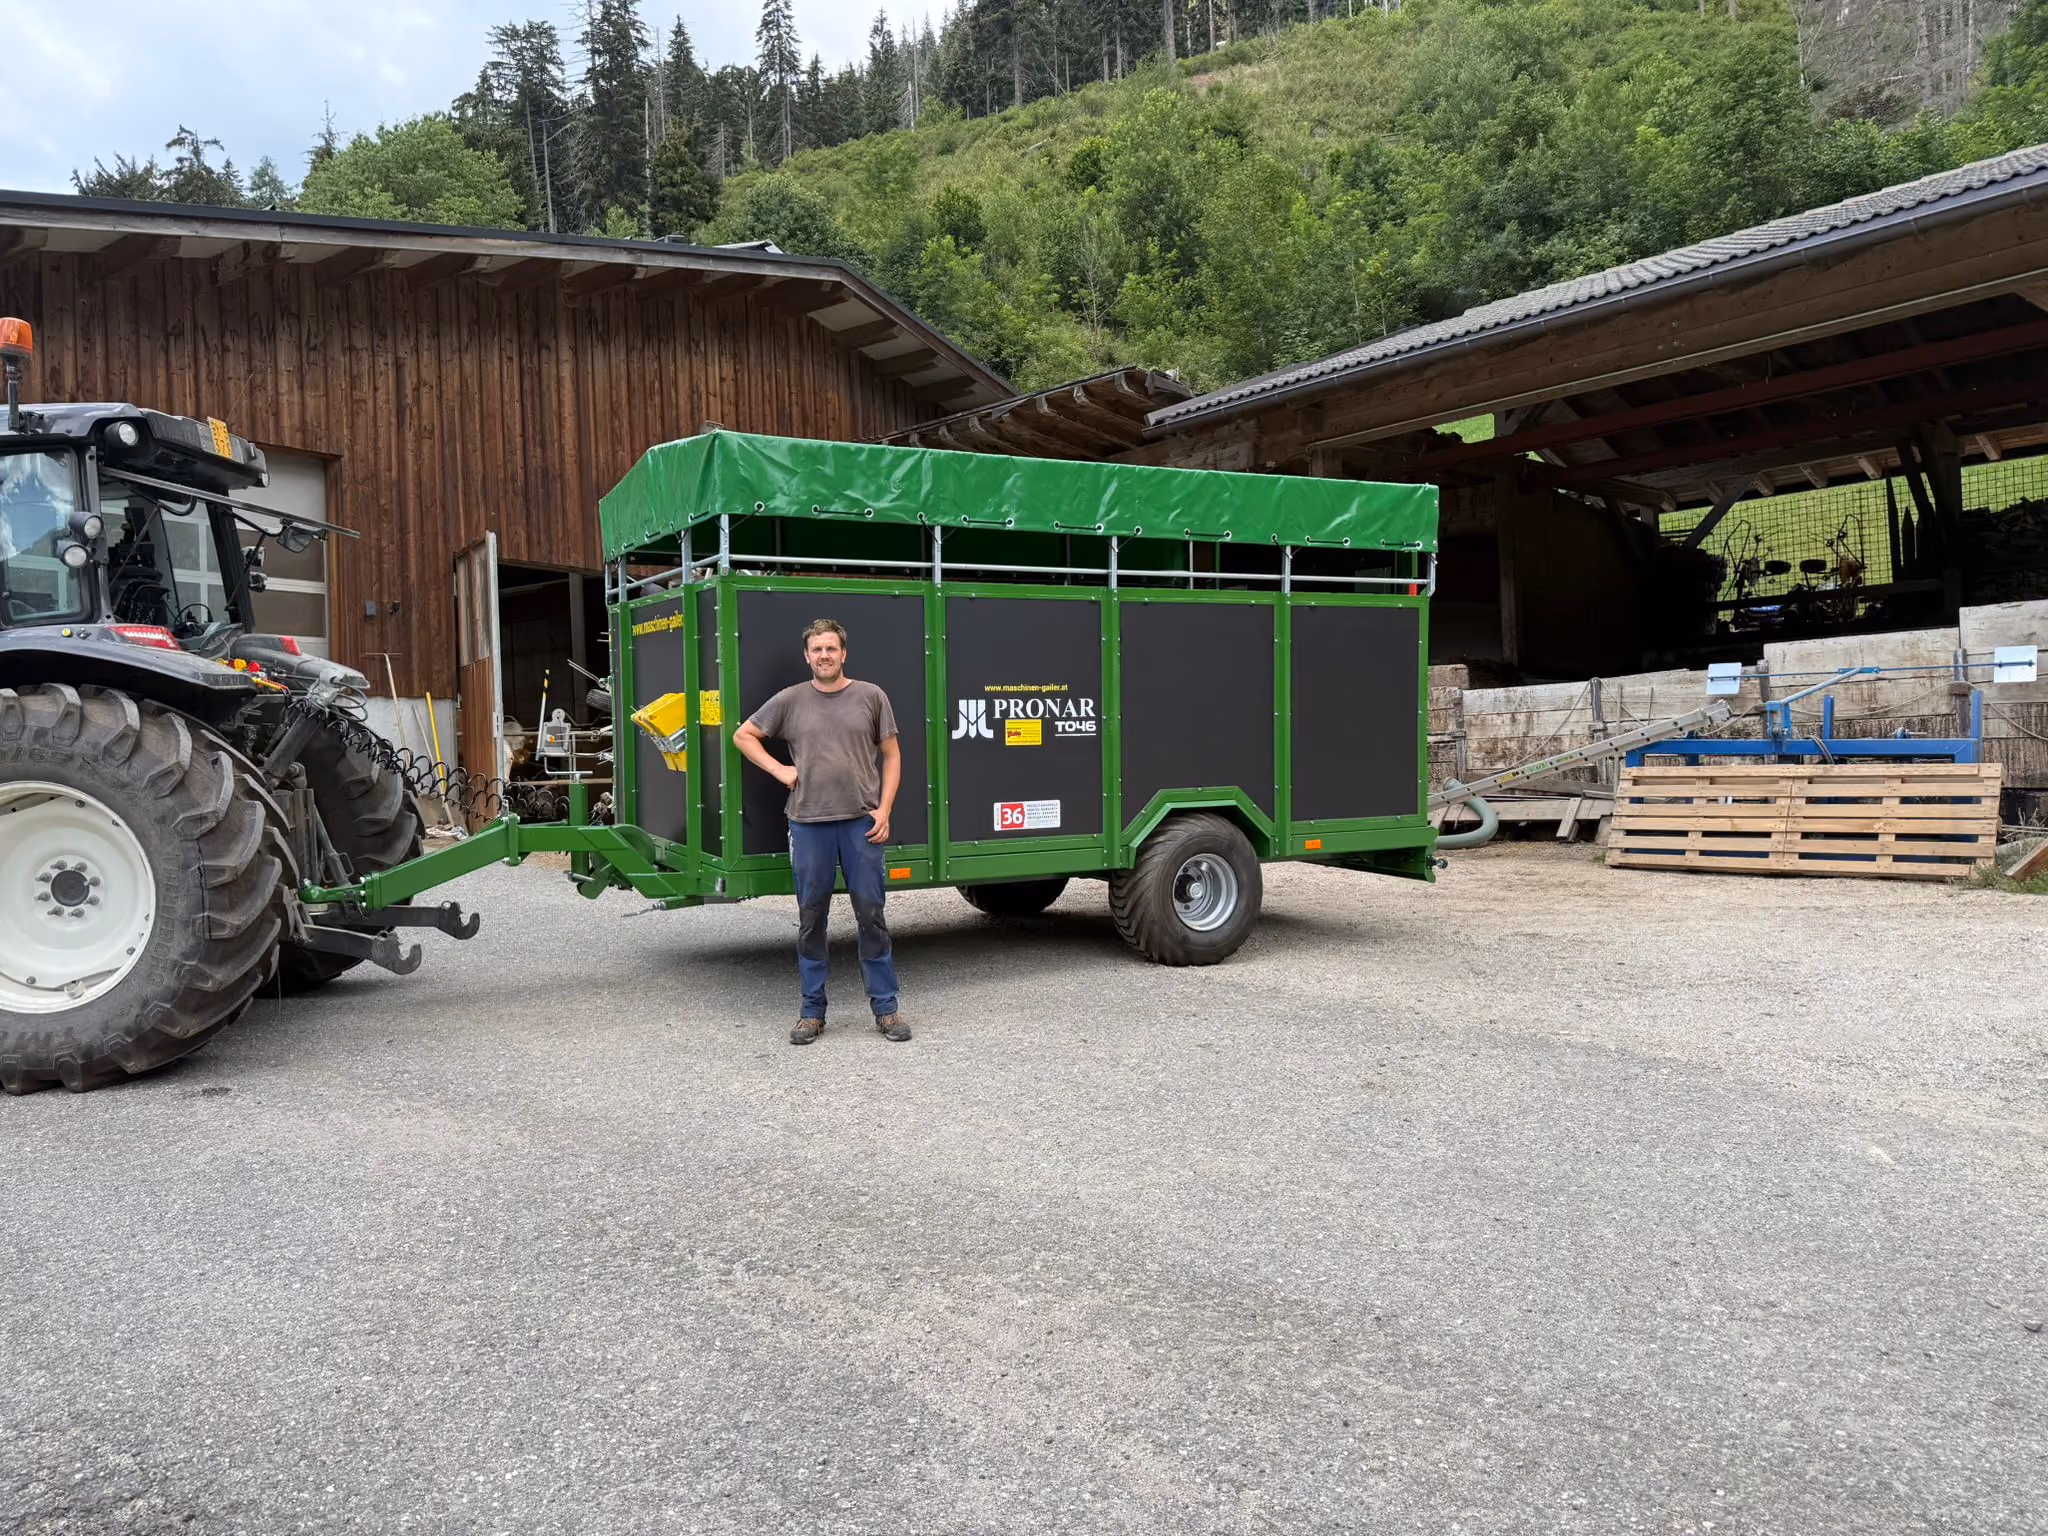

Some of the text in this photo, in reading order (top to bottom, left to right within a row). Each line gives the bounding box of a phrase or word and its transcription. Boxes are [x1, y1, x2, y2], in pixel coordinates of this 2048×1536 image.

[984, 683, 1068, 693] www.maschinen-gailer.at
[992, 698, 1096, 718] PRONAR
[1002, 807, 1024, 825] 36
